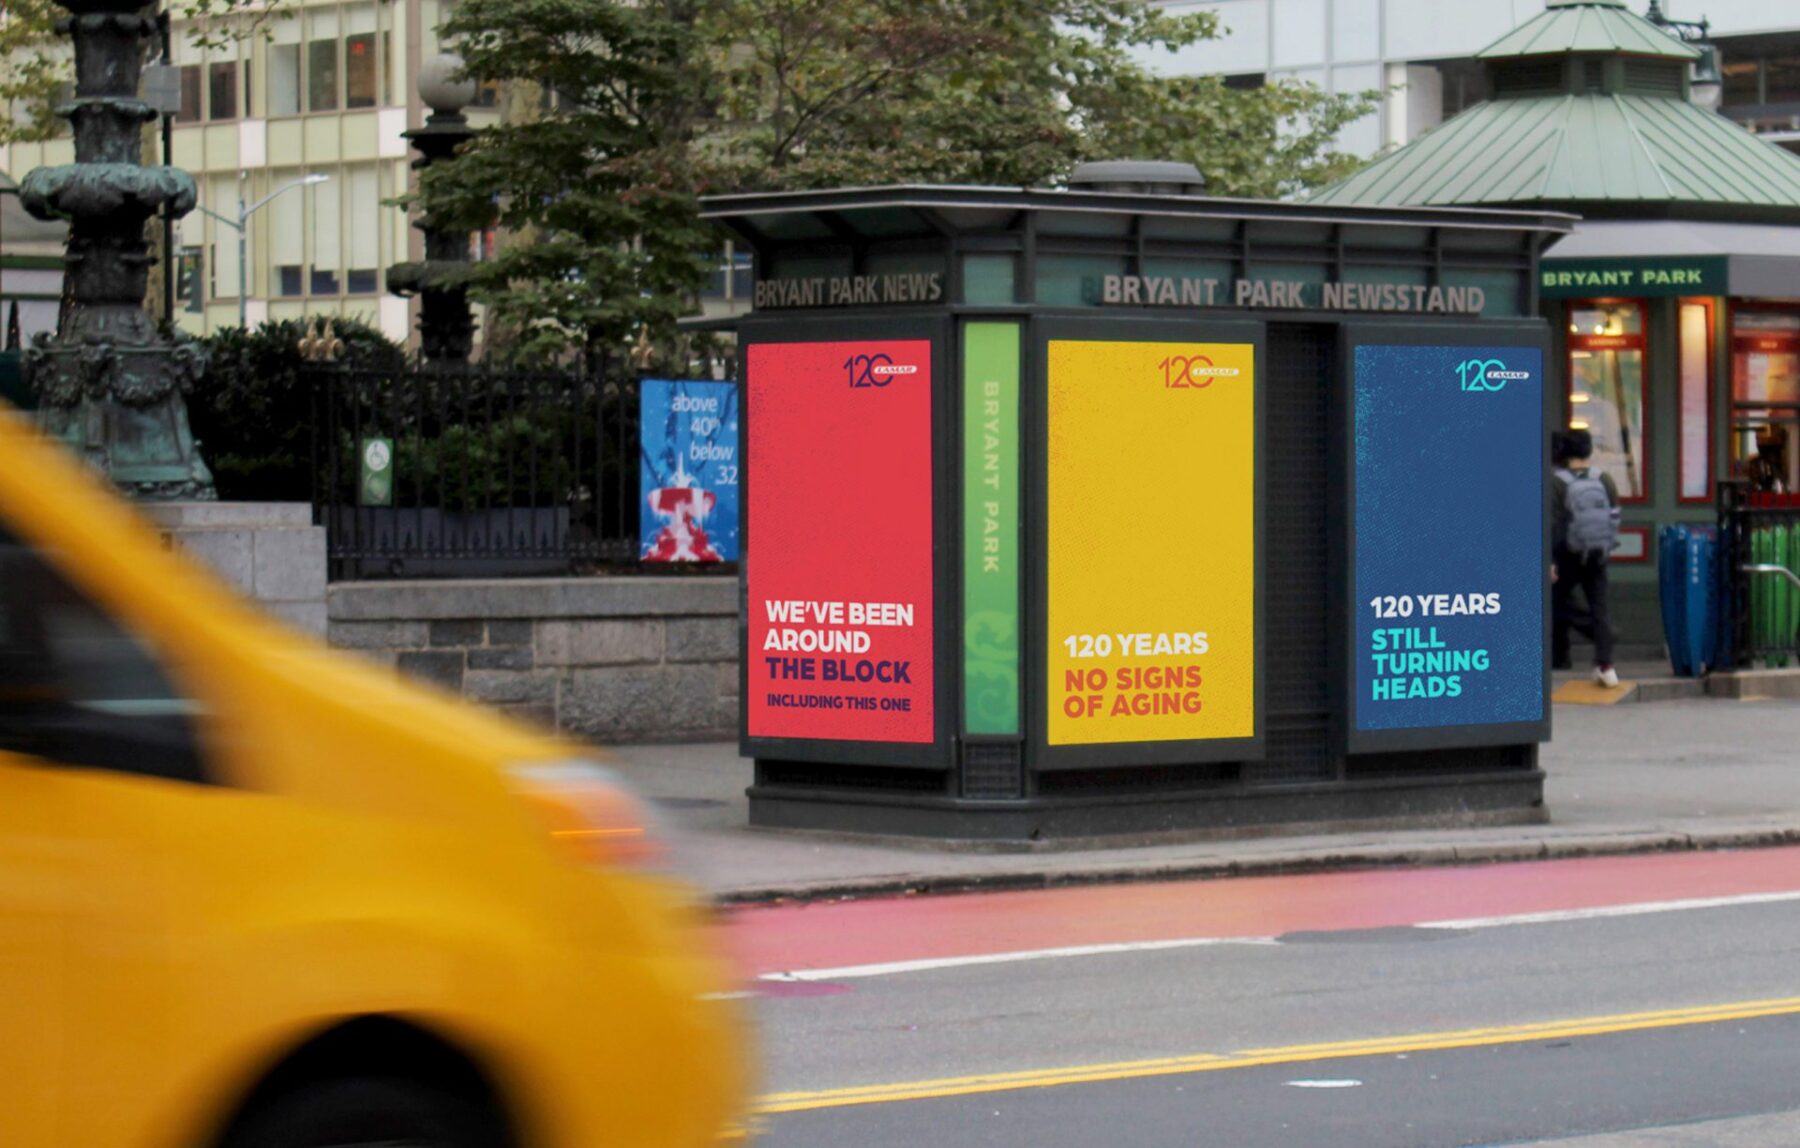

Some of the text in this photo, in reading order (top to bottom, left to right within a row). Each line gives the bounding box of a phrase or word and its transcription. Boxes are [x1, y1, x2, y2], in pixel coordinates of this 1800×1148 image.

[755, 272, 942, 307] BRYANT PARK NEWS
[1542, 269, 1703, 287] BRYANT PARK
[1103, 274, 1485, 313] BRYANT PARK NEWSSTAND
[672, 392, 718, 412] above
[690, 440, 734, 460] below
[983, 381, 999, 573] BRYANT PARK
[765, 599, 914, 626] WE'VE BEEN
[1370, 592, 1501, 619] 120 YEARS
[763, 628, 871, 653] AROUND
[1064, 631, 1209, 658] 120 YEARS
[1372, 626, 1446, 651] STILL
[765, 657, 911, 684] THE BLOCK
[1372, 649, 1490, 675] TURNING
[1065, 665, 1203, 692] NO SIGNS
[1372, 675, 1462, 701] HEADS
[767, 693, 911, 711] INCLUDING THIS ONE
[1063, 691, 1202, 718] OF AGING
